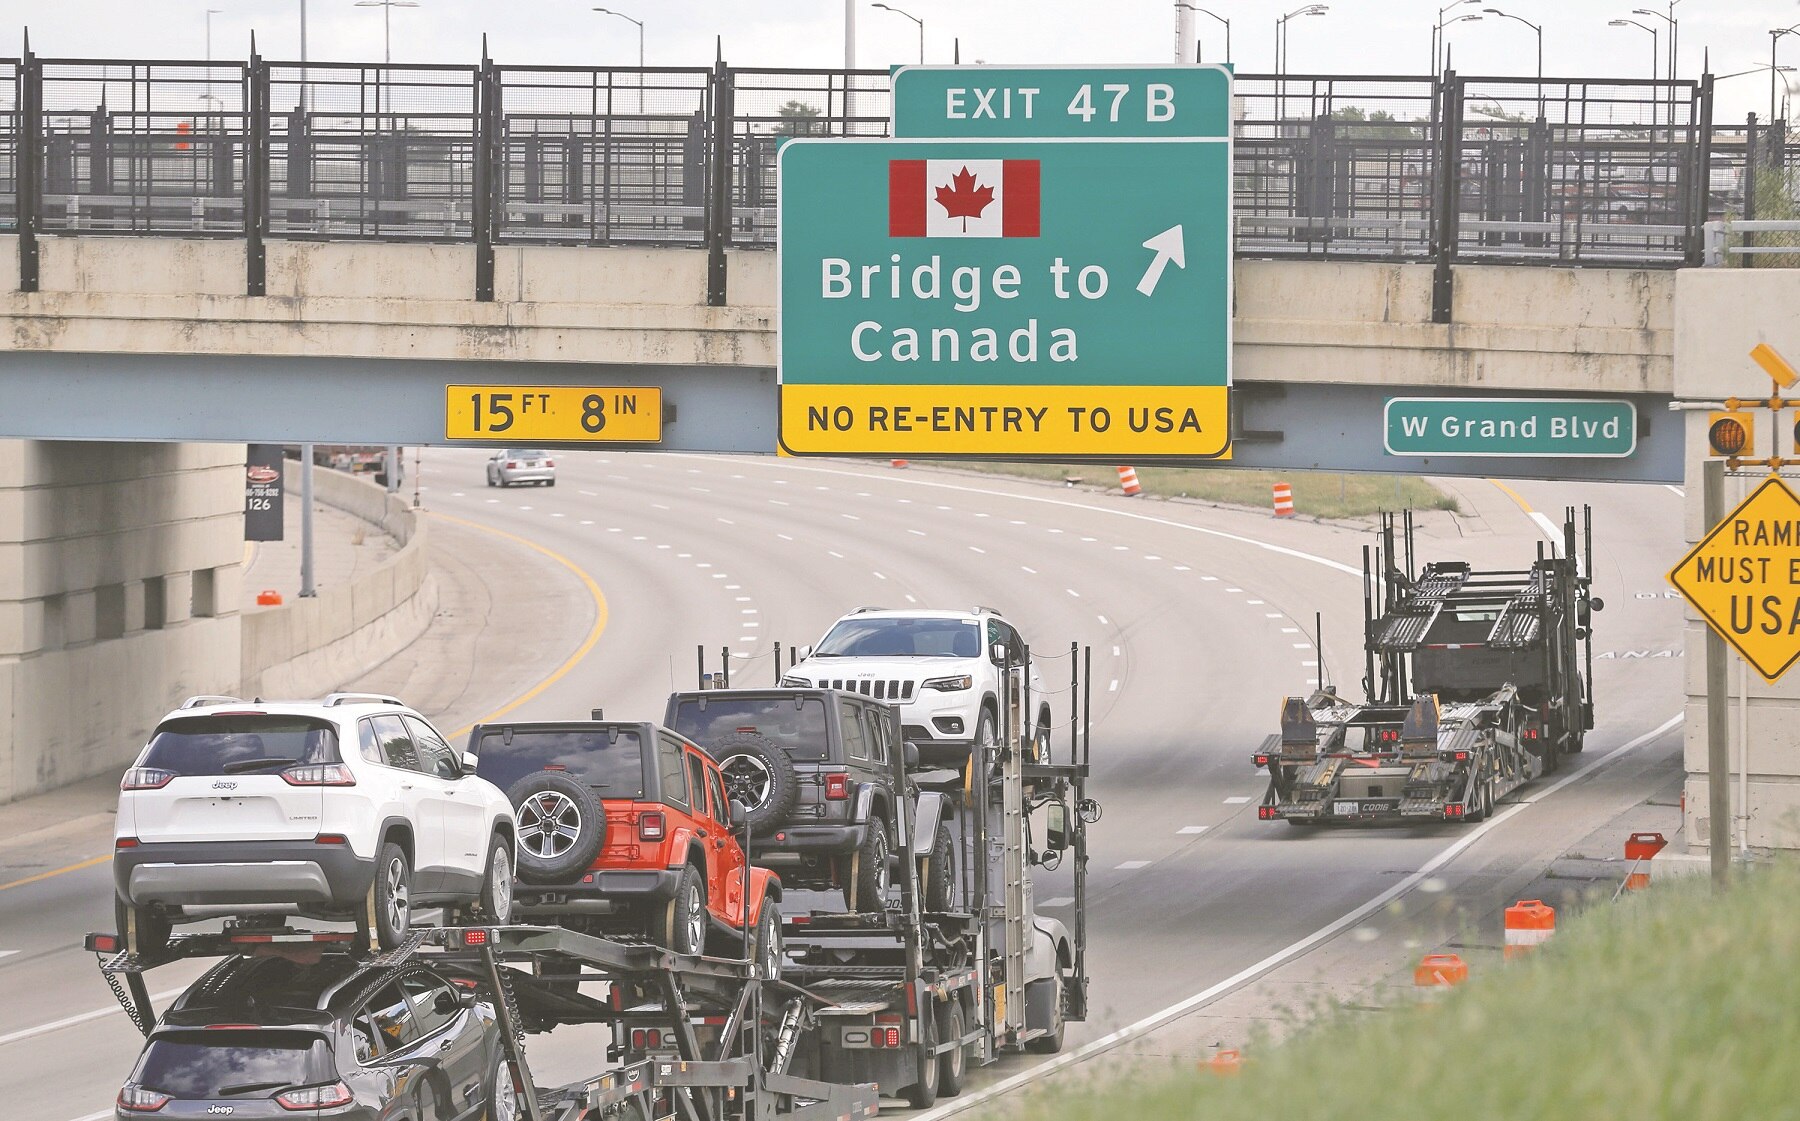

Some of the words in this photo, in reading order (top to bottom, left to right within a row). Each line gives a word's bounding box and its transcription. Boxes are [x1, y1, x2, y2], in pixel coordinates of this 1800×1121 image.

[946, 88, 1040, 119] EXIT
[1067, 84, 1130, 122] 47
[1146, 83, 1176, 122] B
[822, 254, 1021, 312] Bridge
[1049, 257, 1109, 299] to
[851, 319, 1078, 362] Canada
[471, 393, 514, 432] 15
[522, 394, 550, 414] FT
[581, 394, 606, 433] 8
[614, 395, 637, 414] IN
[808, 406, 853, 432] NO
[869, 406, 1048, 432] RE-ENTRY
[1068, 407, 1111, 432] TO
[1128, 407, 1202, 433] USA
[1401, 416, 1429, 437] W
[1441, 415, 1537, 438] Grand
[1551, 416, 1619, 439] Blvd
[248, 498, 271, 511] 126
[1697, 557, 1771, 584] MUST
[212, 780, 238, 790] Jeep
[207, 1104, 234, 1116] Jeep
